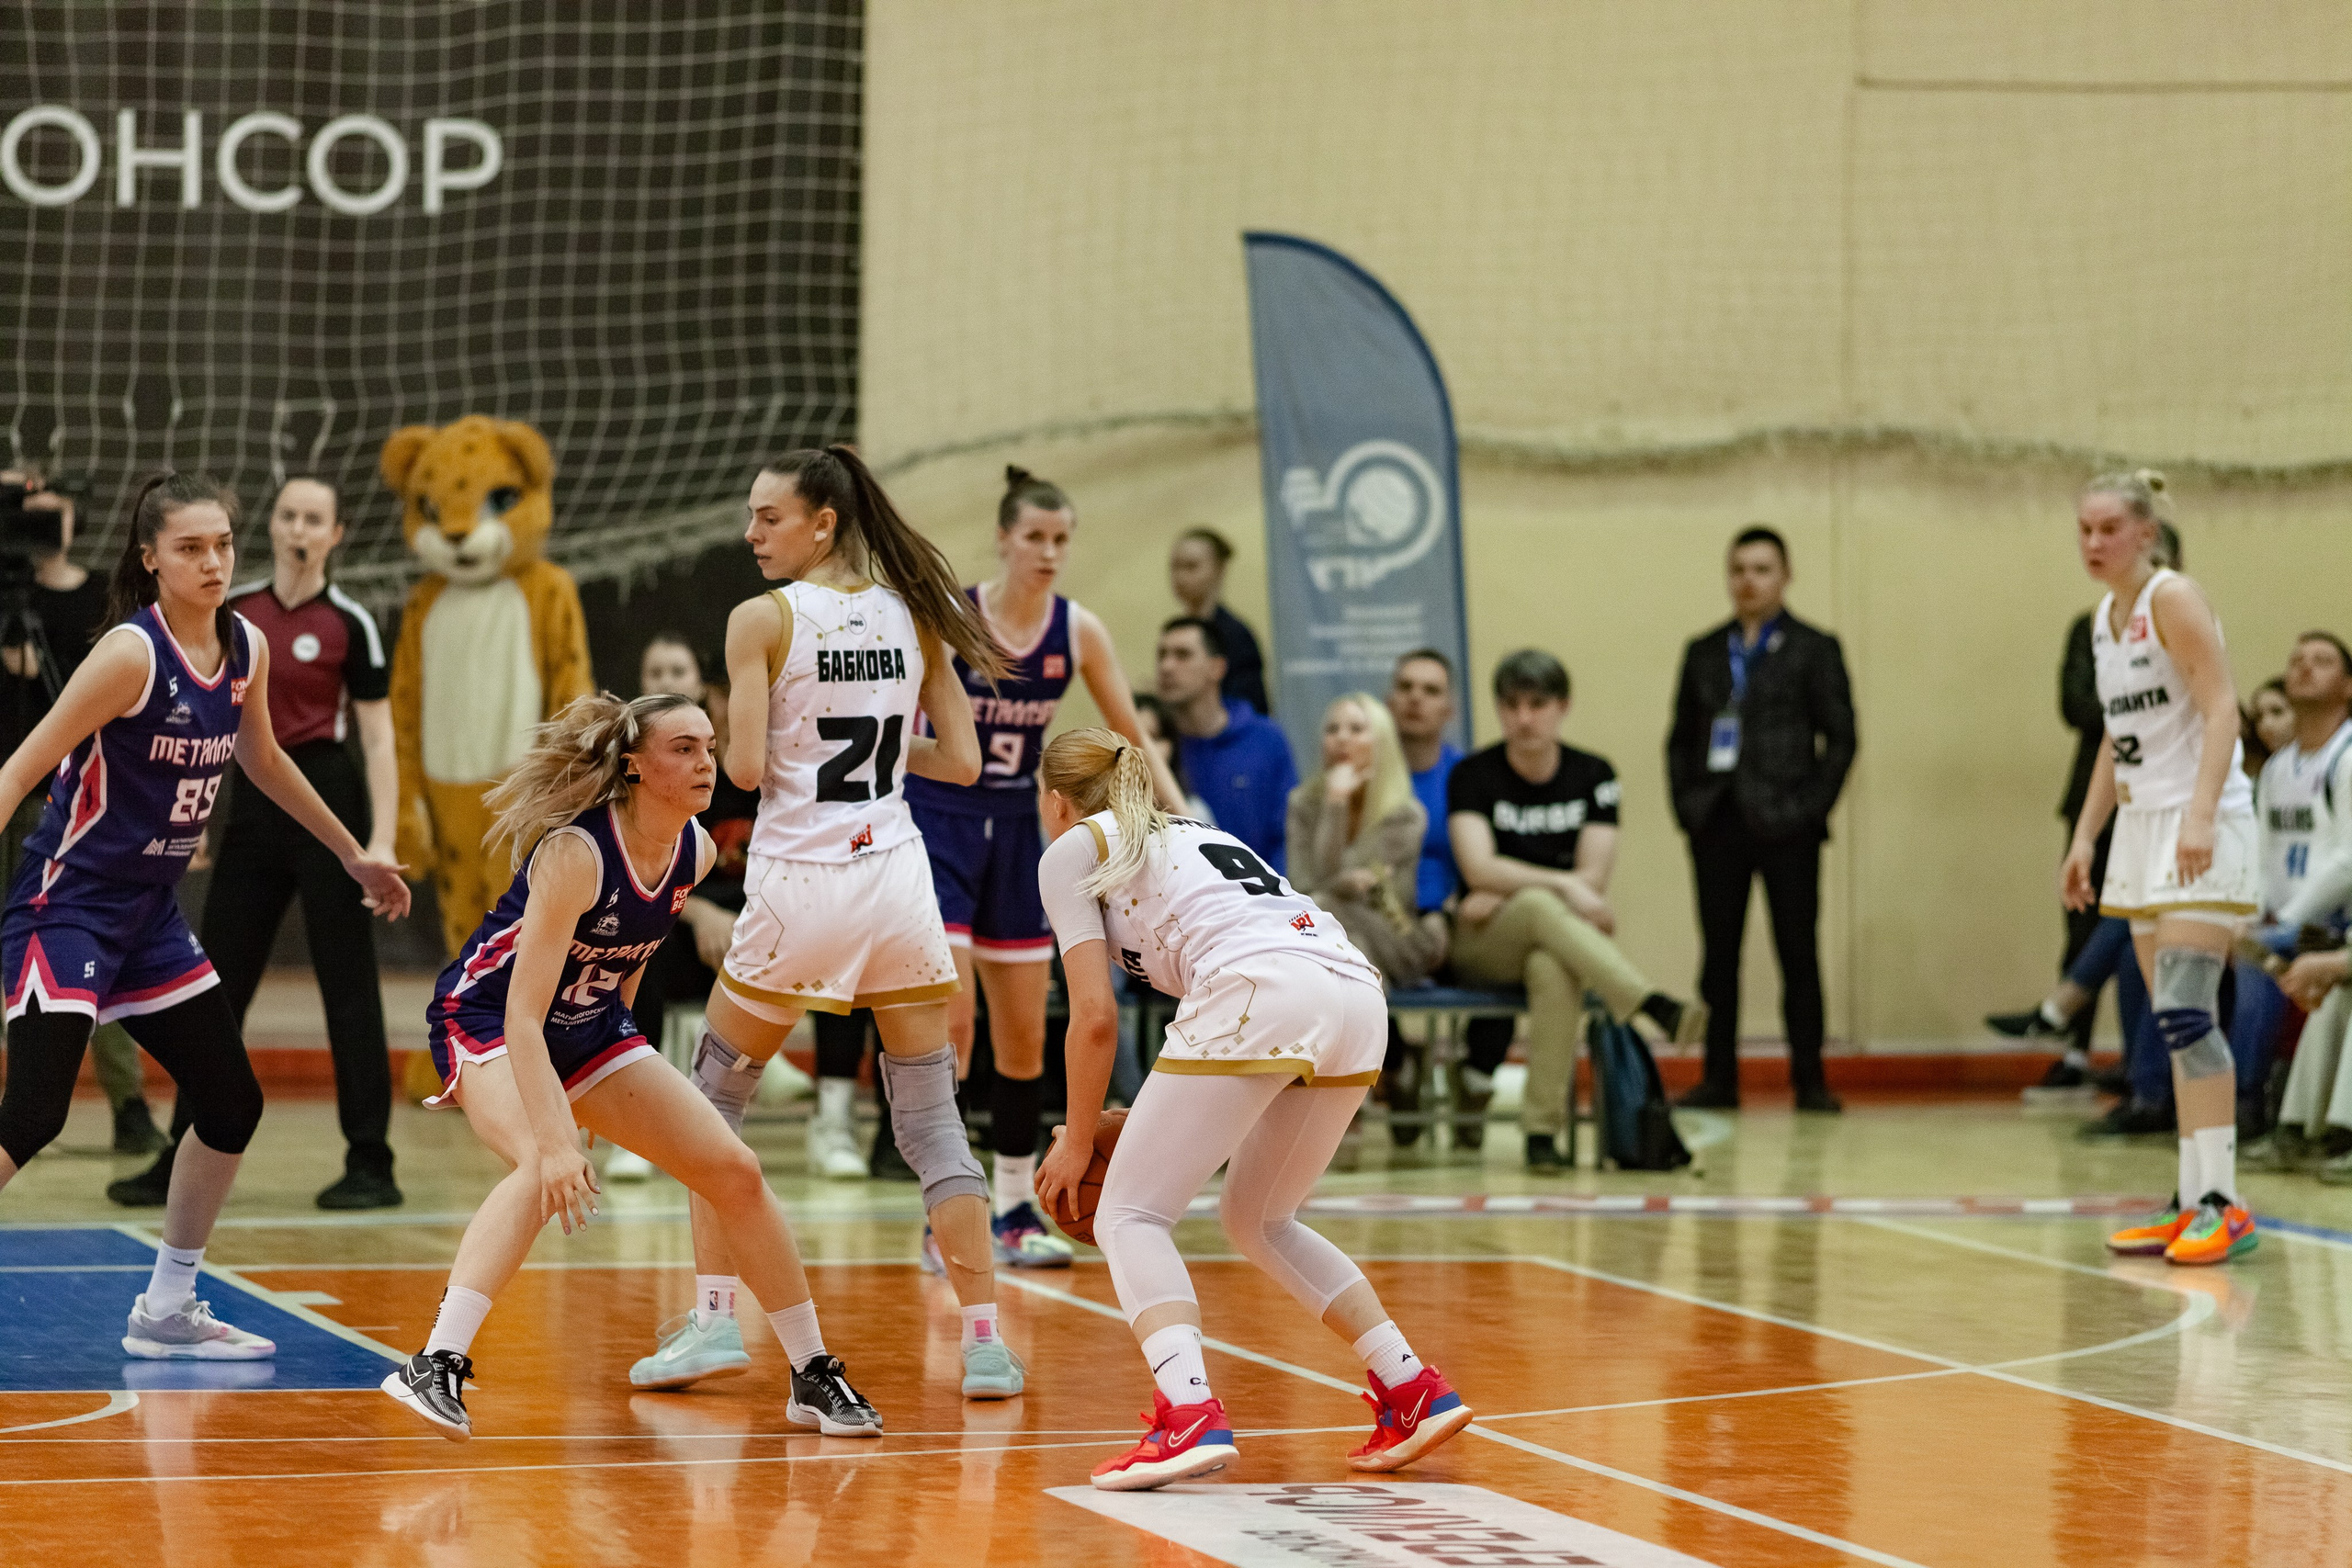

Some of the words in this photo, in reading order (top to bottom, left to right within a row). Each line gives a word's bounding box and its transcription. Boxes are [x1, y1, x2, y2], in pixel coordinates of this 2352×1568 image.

[0, 104, 504, 215] ОНСОР
[817, 648, 907, 682] БАБКОВА
[815, 714, 905, 804] 21
[983, 732, 1026, 776] 9
[169, 773, 223, 823] 89
[1197, 842, 1286, 897] 9
[561, 964, 624, 1007] 12
